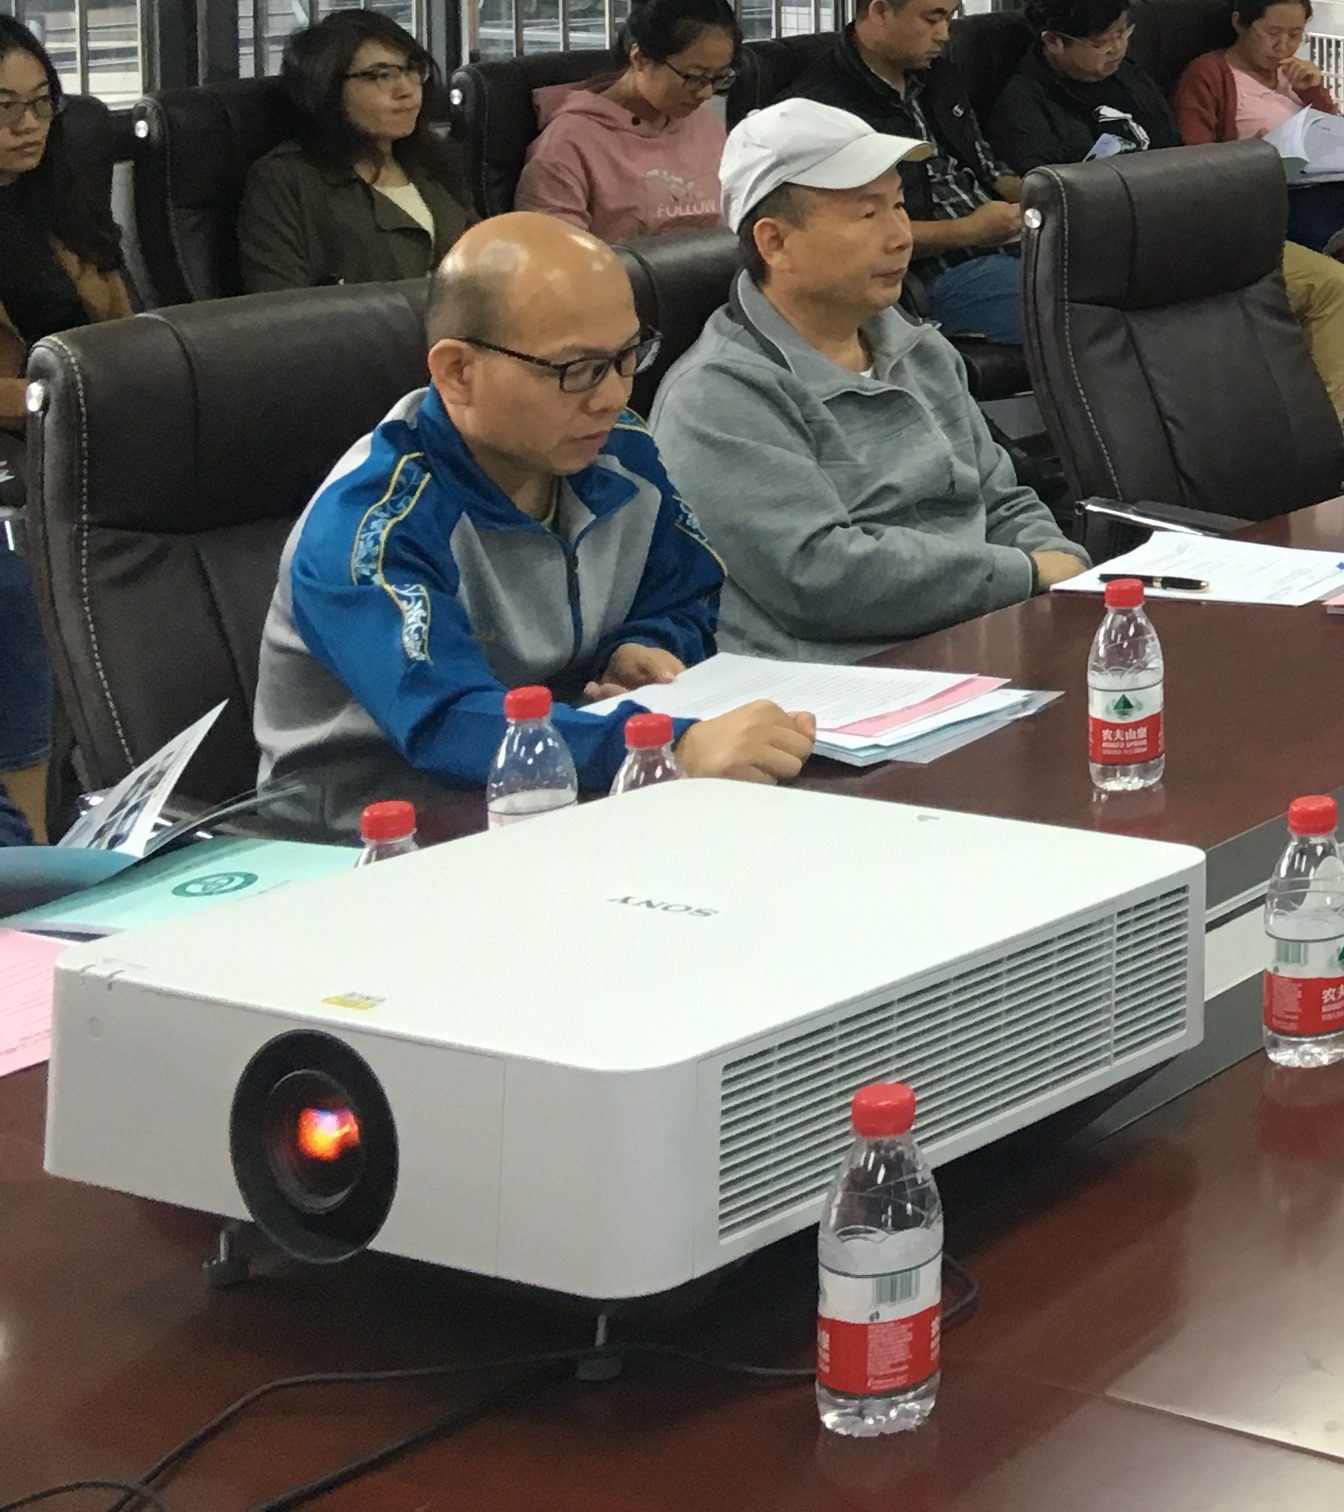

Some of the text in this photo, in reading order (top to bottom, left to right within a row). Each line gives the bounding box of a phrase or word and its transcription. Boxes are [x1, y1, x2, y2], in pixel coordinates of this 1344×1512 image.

[1102, 726, 1147, 742] 农夫山泉
[604, 895, 720, 917] SONY
